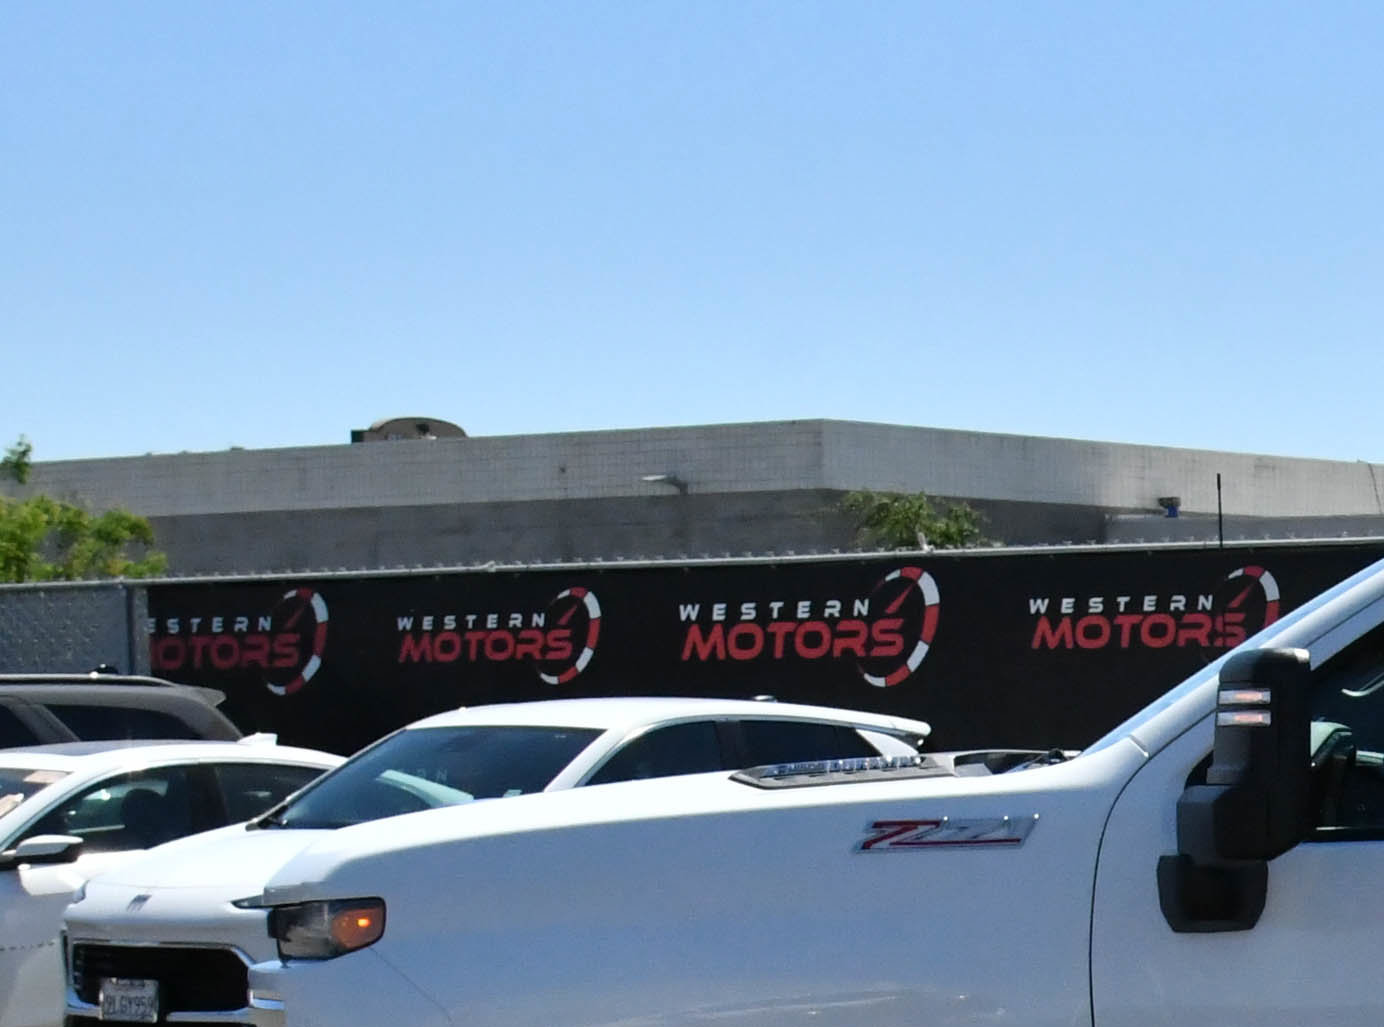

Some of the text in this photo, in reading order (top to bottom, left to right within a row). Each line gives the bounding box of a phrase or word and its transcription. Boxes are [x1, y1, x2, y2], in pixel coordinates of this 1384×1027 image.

[679, 598, 870, 622] WESTERN
[1029, 594, 1213, 615] WESTERN
[144, 616, 272, 634] ESTERN
[397, 612, 545, 631] WESTERN
[1031, 612, 1247, 650] MOTORS
[152, 632, 300, 669] OTORS
[399, 628, 574, 663] MOTORS
[681, 617, 905, 662] MOTORS
